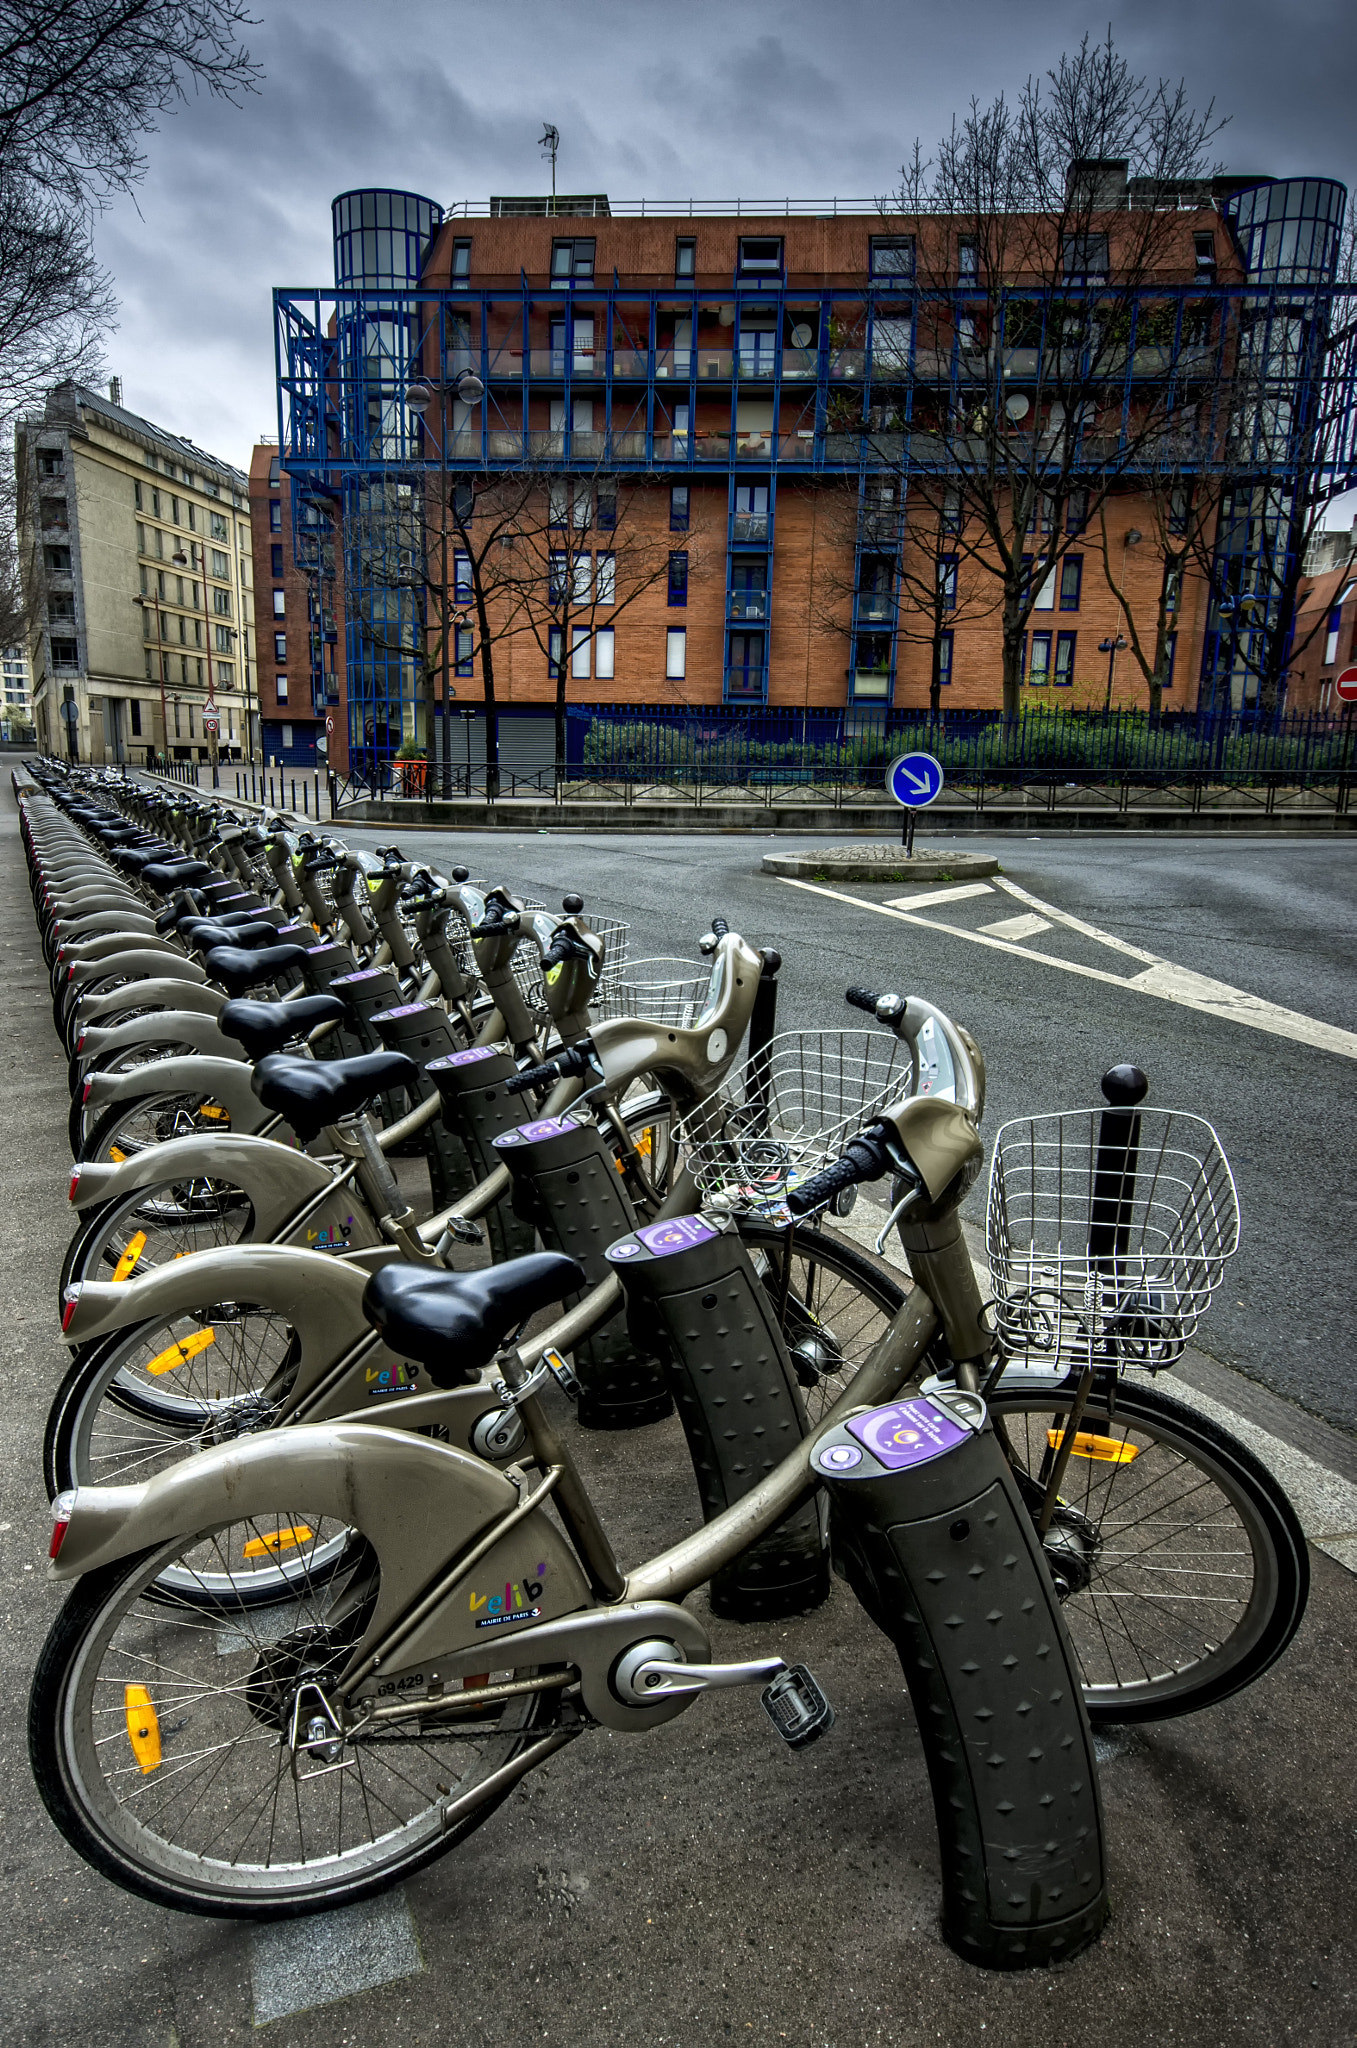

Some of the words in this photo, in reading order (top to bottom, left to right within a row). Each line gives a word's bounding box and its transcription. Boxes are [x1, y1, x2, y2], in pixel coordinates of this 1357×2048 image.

[955, 1403, 974, 1413] 01
[480, 1616, 502, 1626] MAIRIE
[512, 1611, 529, 1620] PARIS
